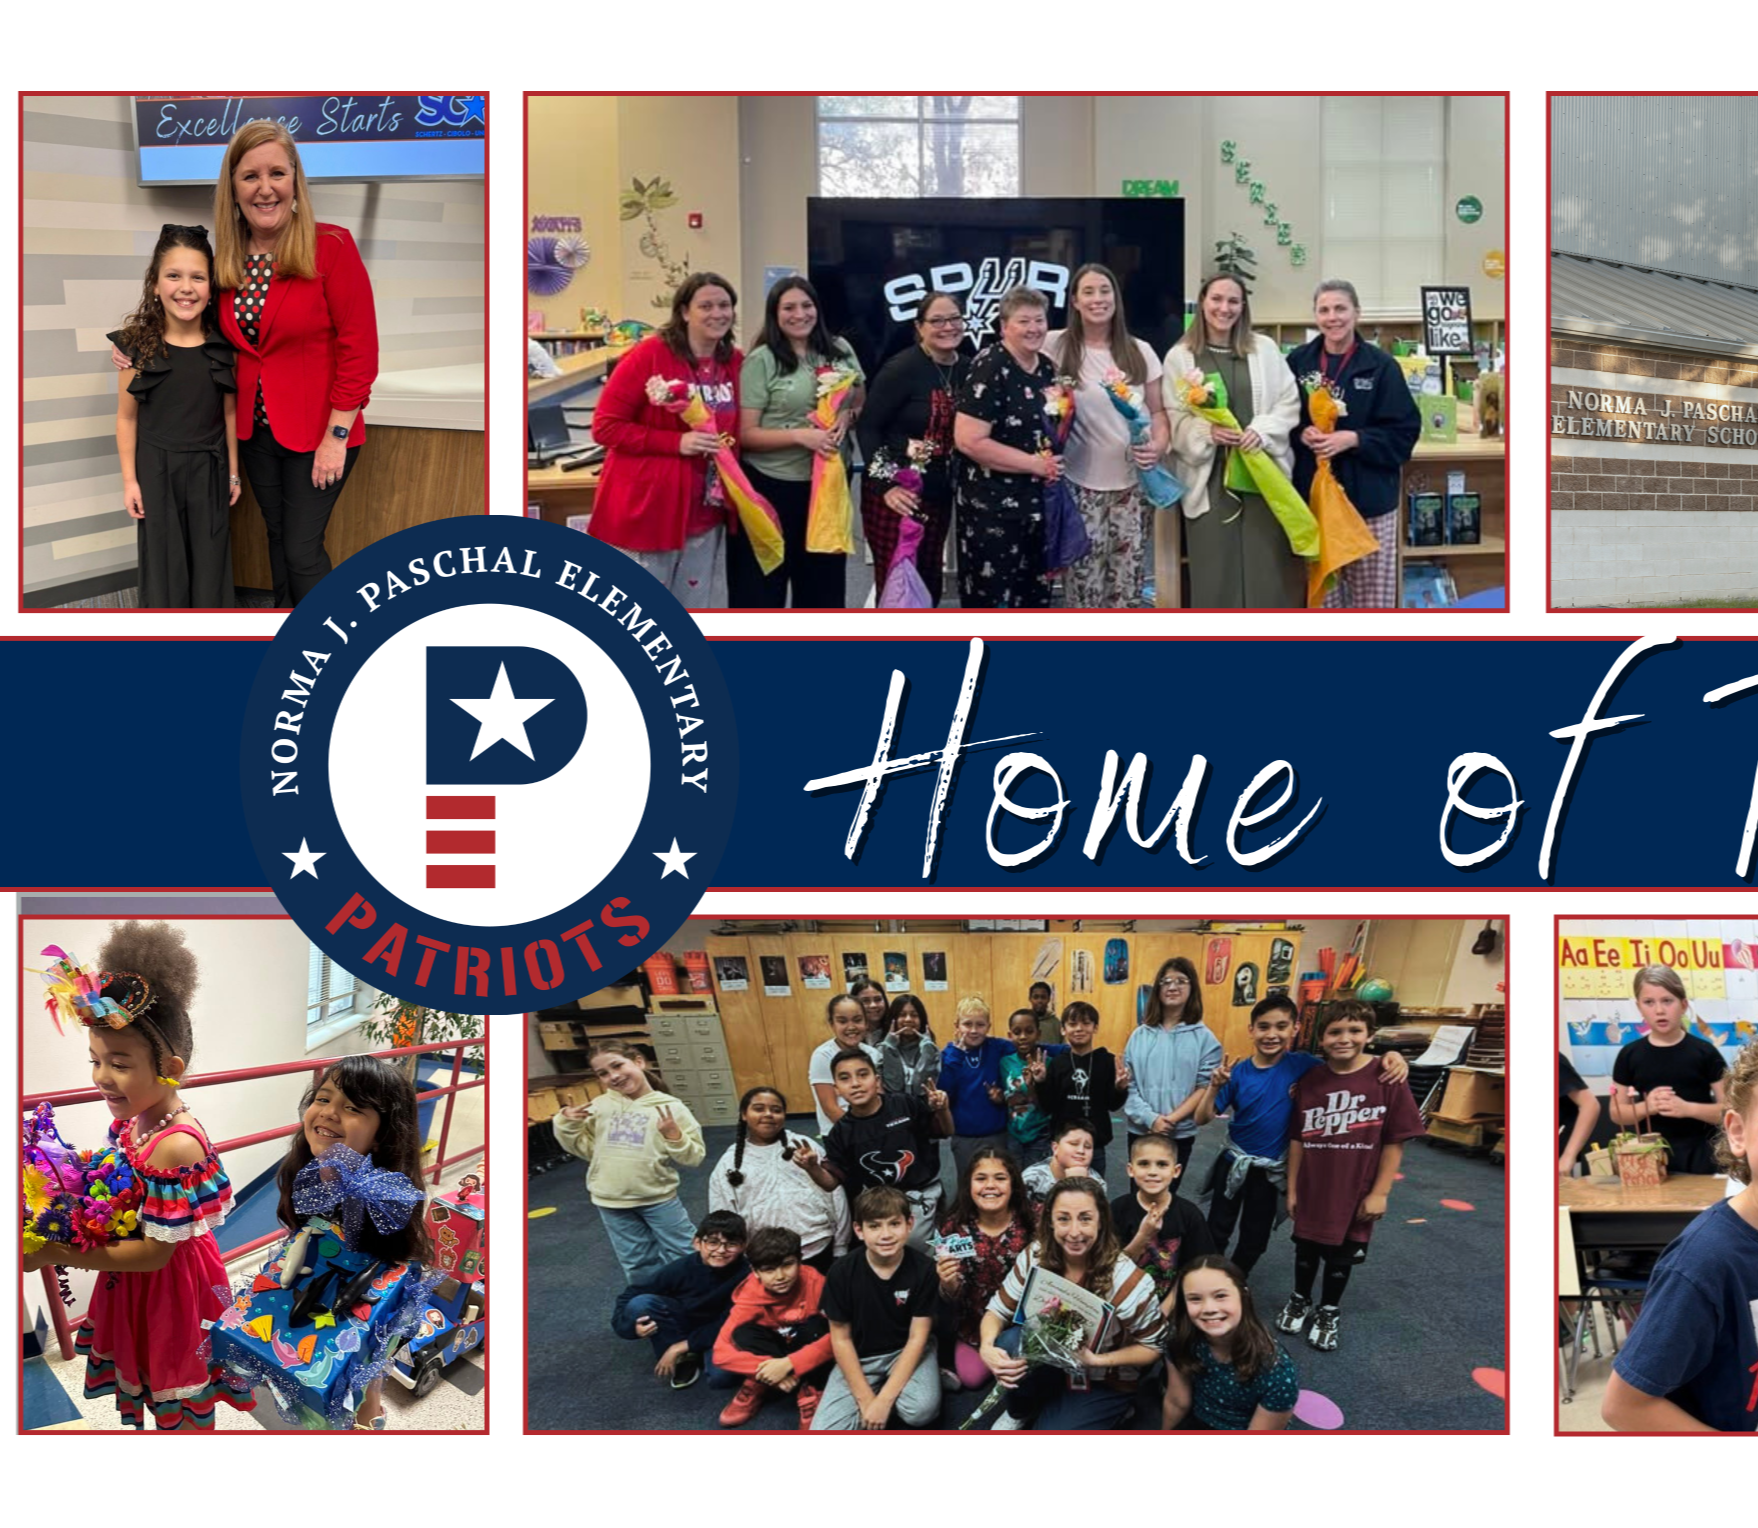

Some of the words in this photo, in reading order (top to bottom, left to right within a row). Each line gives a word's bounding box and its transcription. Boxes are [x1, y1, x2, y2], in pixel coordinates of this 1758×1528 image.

[316, 96, 404, 136] Starts
[1568, 390, 1648, 416] NORMA
[1660, 400, 1676, 418] J.
[1551, 414, 1696, 442] ELEMENTARY
[1561, 939, 1589, 967] Aa
[1593, 939, 1621, 968] Ee
[1659, 940, 1689, 968] Oo
[1692, 942, 1720, 968] Uu
[1325, 1090, 1366, 1114] Dr
[1301, 1105, 1387, 1137] Pepper
[949, 1243, 974, 1253] ARTS
